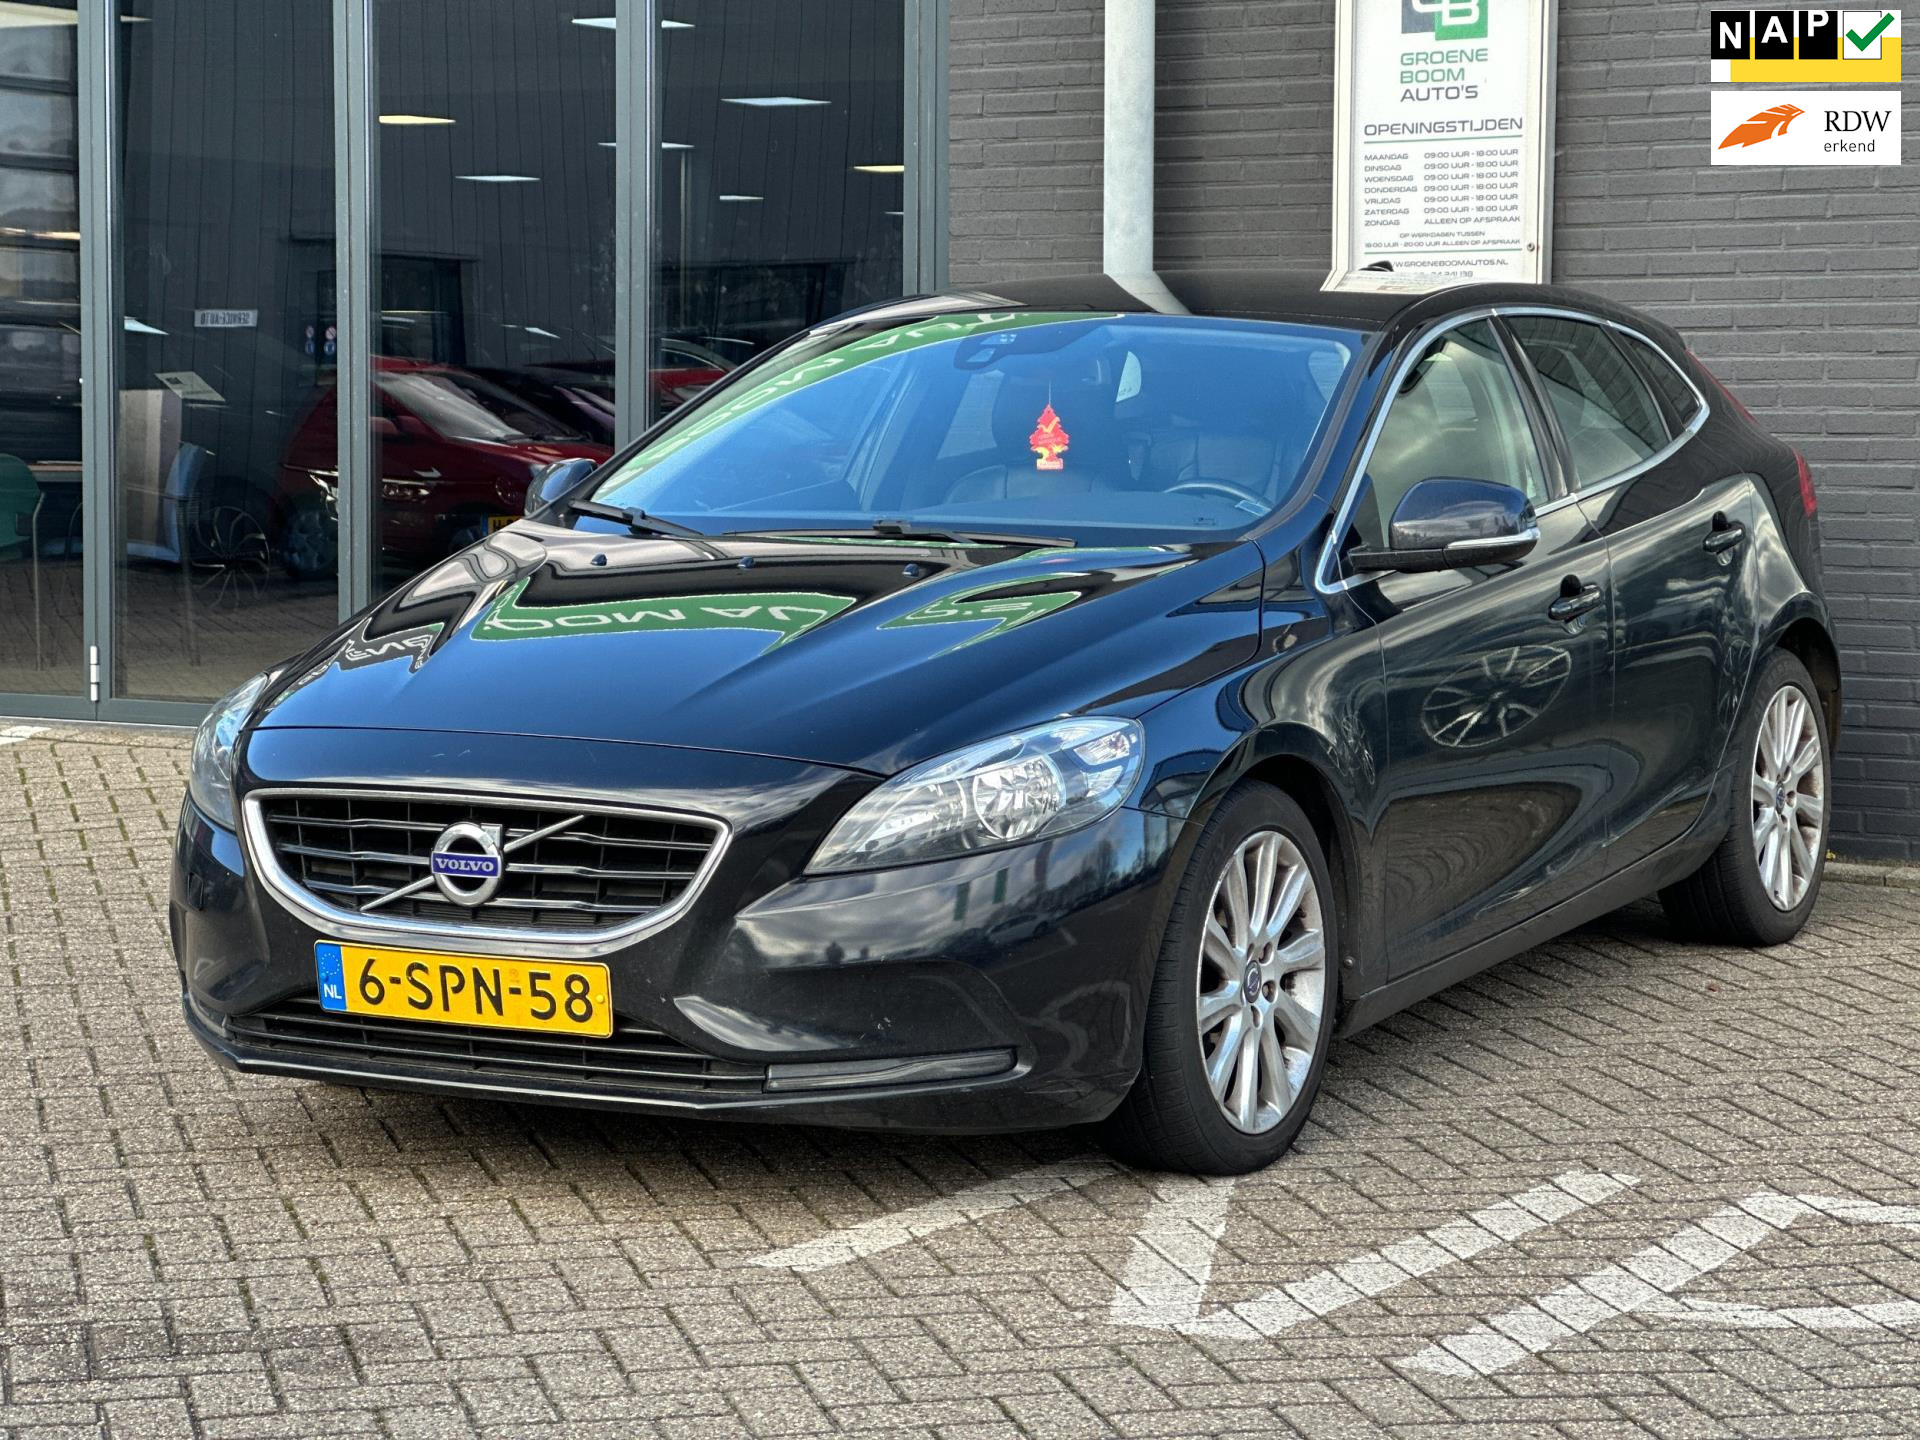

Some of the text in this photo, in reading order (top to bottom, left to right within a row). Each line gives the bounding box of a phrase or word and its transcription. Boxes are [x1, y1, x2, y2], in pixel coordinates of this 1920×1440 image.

[1400, 48, 1488, 66] GROENE
[1400, 68, 1465, 84] BOOM
[1400, 85, 1479, 102] AUTO'S
[1363, 117, 1522, 136] OPENINGSTIJDEN
[1364, 153, 1409, 161] MAANDAG
[1499, 148, 1519, 156] UUR
[1364, 164, 1402, 172] DINSDAG
[1364, 175, 1414, 183] WOENSDAG
[1364, 186, 1418, 194] DONDERDAG
[1364, 197, 1401, 205] VRIJDAG
[1364, 208, 1410, 216] ZATERDAG
[1499, 204, 1519, 212] UUR
[1364, 219, 1400, 227] ZONDAG
[435, 857, 495, 873] VOLVO
[323, 984, 342, 1000] NL
[358, 958, 594, 1023] 6-SPN-58
